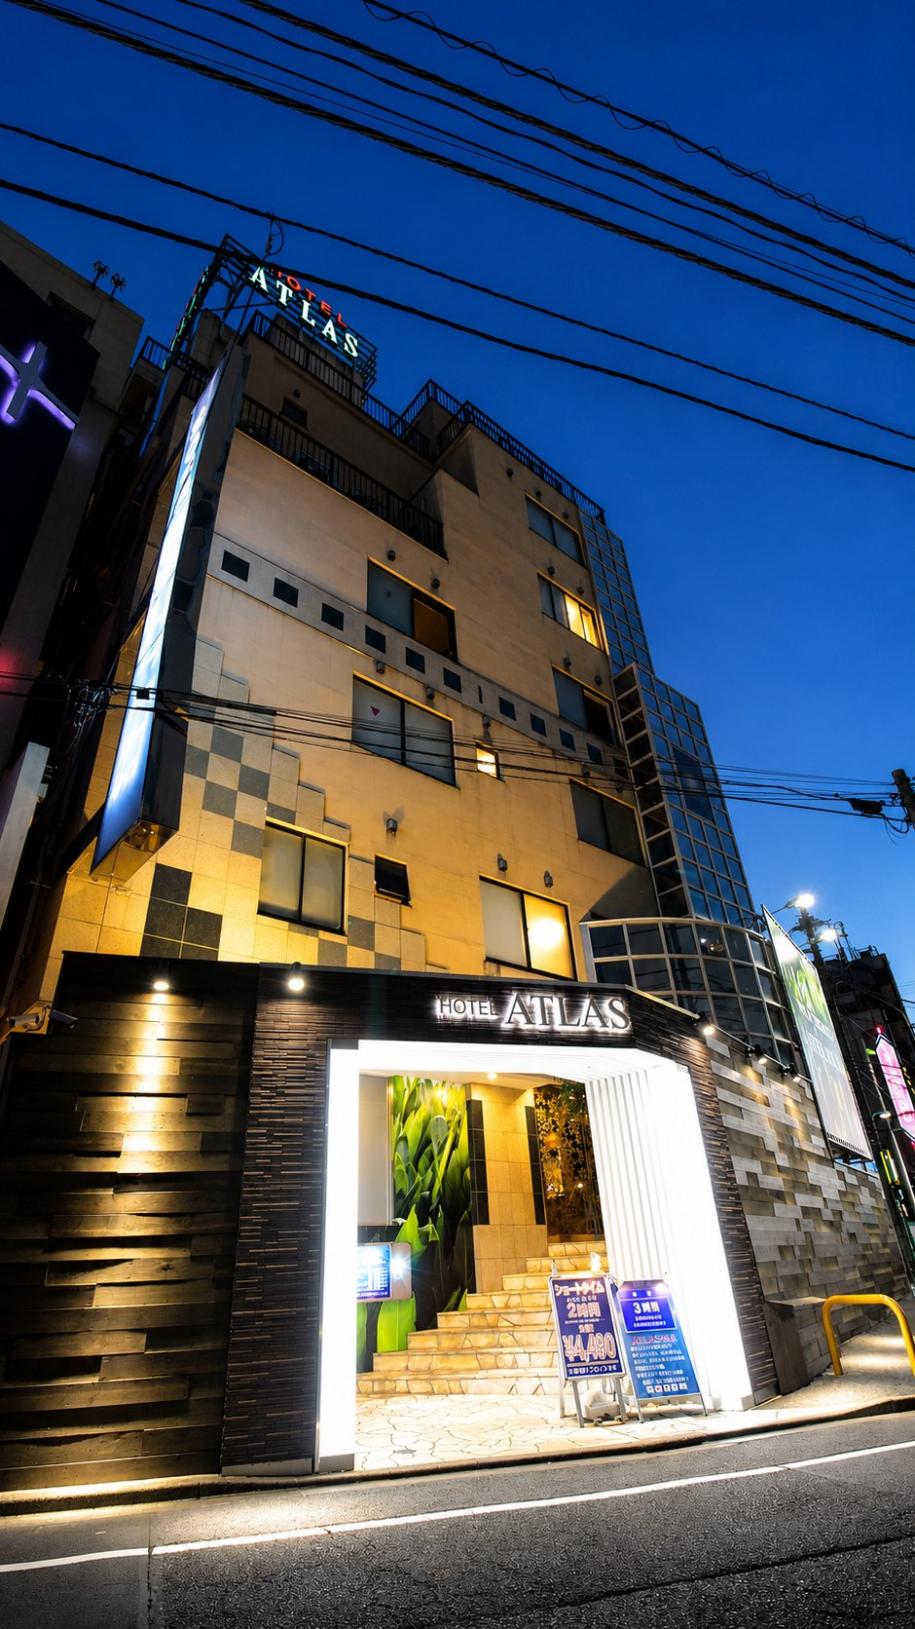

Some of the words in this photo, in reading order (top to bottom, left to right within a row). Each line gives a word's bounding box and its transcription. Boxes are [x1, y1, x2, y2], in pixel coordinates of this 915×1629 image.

[248, 266, 359, 358] ATLAS
[439, 998, 497, 1017] HOTEL
[504, 993, 632, 1031] ATLAS
[554, 1281, 606, 1297] ショートタイム
